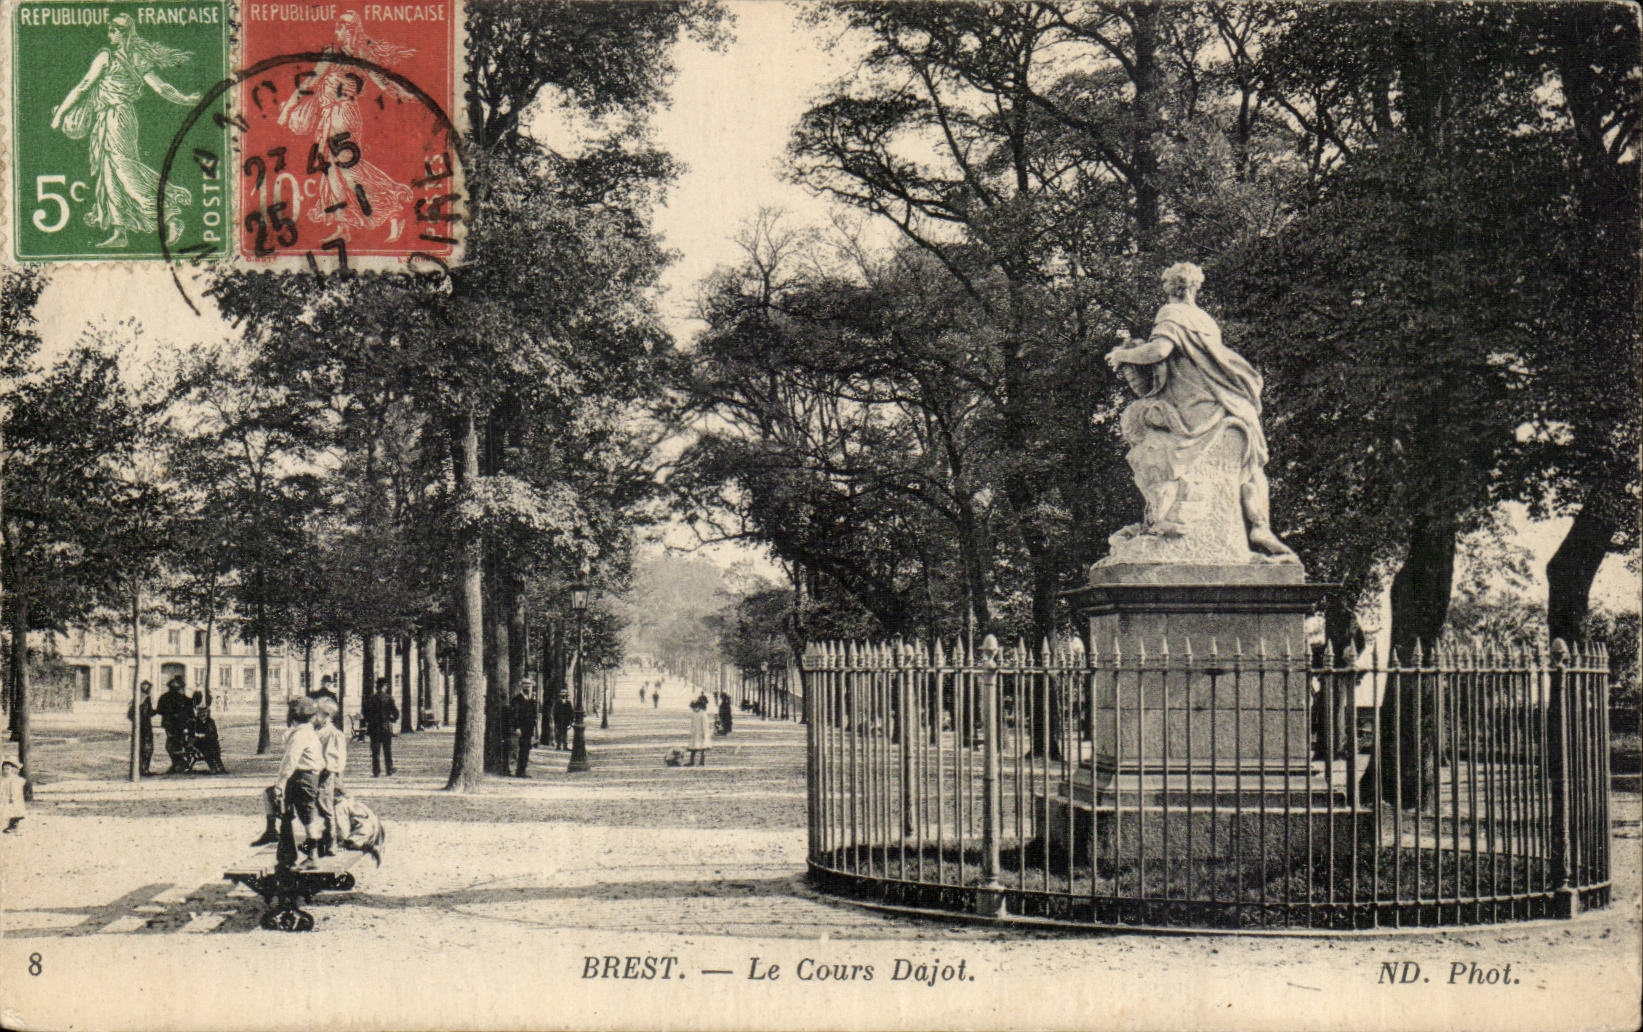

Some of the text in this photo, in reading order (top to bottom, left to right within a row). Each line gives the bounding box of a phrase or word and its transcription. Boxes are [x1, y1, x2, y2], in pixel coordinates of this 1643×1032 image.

[137, 6, 219, 26] FRANÇAISE
[363, 4, 445, 24] FRANÇAISE
[306, 131, 361, 176] 45
[244, 203, 299, 258] 25
